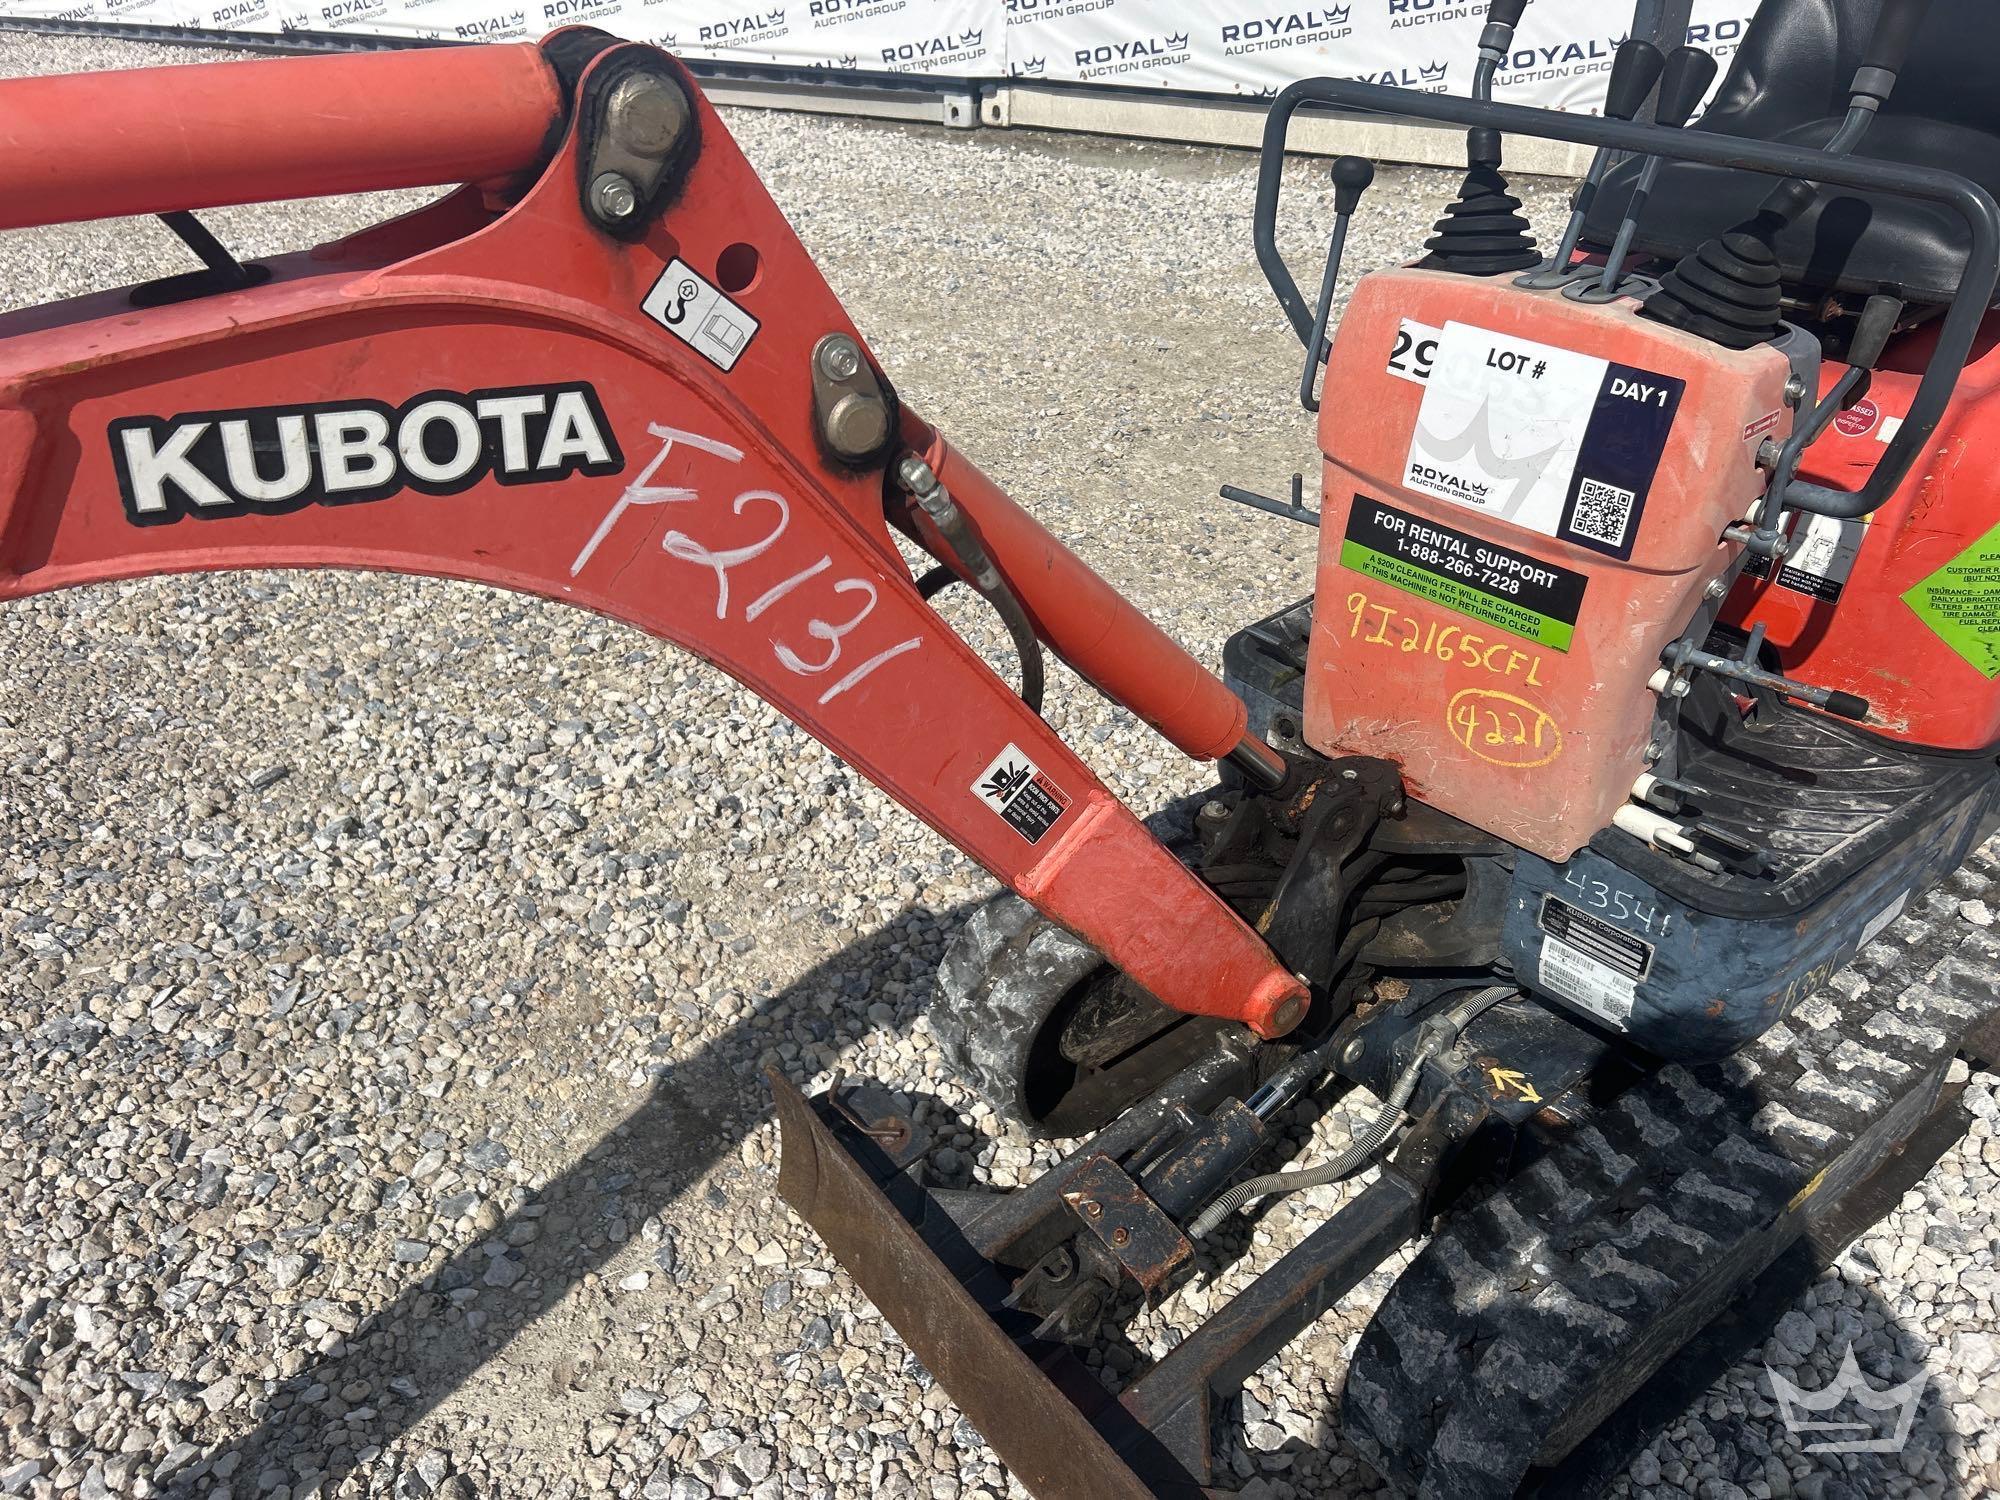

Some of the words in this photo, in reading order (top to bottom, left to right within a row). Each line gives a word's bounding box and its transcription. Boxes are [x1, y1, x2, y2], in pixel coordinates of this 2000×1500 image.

[213, 1, 255, 23] ROYAL
[321, 0, 373, 20] ROYAL
[328, 15, 359, 29] AUCTION
[359, 8, 388, 23] GROUP
[547, 14, 588, 29] AUCTION
[589, 5, 623, 22] GROUP
[809, 0, 881, 17] ROY
[814, 11, 863, 29] AUCTION
[865, 1, 907, 18] GROUP
[1006, 9, 1064, 26] AUCTION
[1066, 0, 1115, 15] GROUP
[1390, 8, 1467, 29] AUCTION
[455, 16, 510, 38] ROYAL
[699, 15, 767, 41] ROYAL
[704, 37, 749, 51] AUCTION
[750, 27, 790, 43] GROUP
[1221, 11, 1323, 43] ROYAL
[882, 35, 959, 63] ROYAL
[1075, 39, 1164, 67] ROYAL
[1224, 37, 1293, 56] AUCTION
[1295, 27, 1353, 45] GROUP
[887, 58, 939, 75] AUCTION
[940, 48, 987, 65] GROUP
[1079, 63, 1139, 80] AUCTION
[1140, 53, 1191, 70] GROUP
[1495, 39, 1607, 72] ROYAL
[1491, 63, 1572, 87] AUCTION
[1573, 60, 1613, 77] GRO
[1486, 347, 1530, 375] LOT
[1532, 360, 1547, 380] #
[1609, 377, 1658, 404] DAY
[1656, 389, 1668, 408] 1
[1850, 404, 1874, 417] ASSED
[120, 391, 612, 513] KUBOTA
[1409, 475, 1451, 496] AUCTION
[1451, 489, 1486, 505] GROUP
[1411, 463, 1470, 492] ROYAL
[1373, 510, 1406, 535] FOR
[1408, 524, 1470, 558] RENTAL
[1474, 547, 1558, 590] SUPPORT
[1396, 537, 1520, 595] 1-888-266-7228
[1362, 562, 1371, 571] IF
[1371, 564, 1389, 580] THIS
[1390, 570, 1428, 596] MACHINE
[1429, 586, 1438, 598] IS
[1438, 589, 1457, 606] NOT
[1458, 600, 1507, 626] RETURNED
[1508, 618, 1540, 638] CLEAN
[1369, 555, 1376, 563] A
[1377, 556, 1395, 571] $200
[1396, 560, 1439, 588] CLEANING
[1439, 581, 1457, 595] FEE
[1458, 587, 1480, 605] WILL
[1481, 597, 1494, 609] BE
[1495, 602, 1541, 627] CHARGED
[1927, 587, 1973, 596] INSURANCE
[1931, 595, 1955, 603] DAILY
[1931, 602, 1963, 610] FILTERS
[1042, 780, 1068, 805] WARNING
[1566, 906, 1598, 926] KUBOTA
[1598, 921, 1642, 949] Corporation
